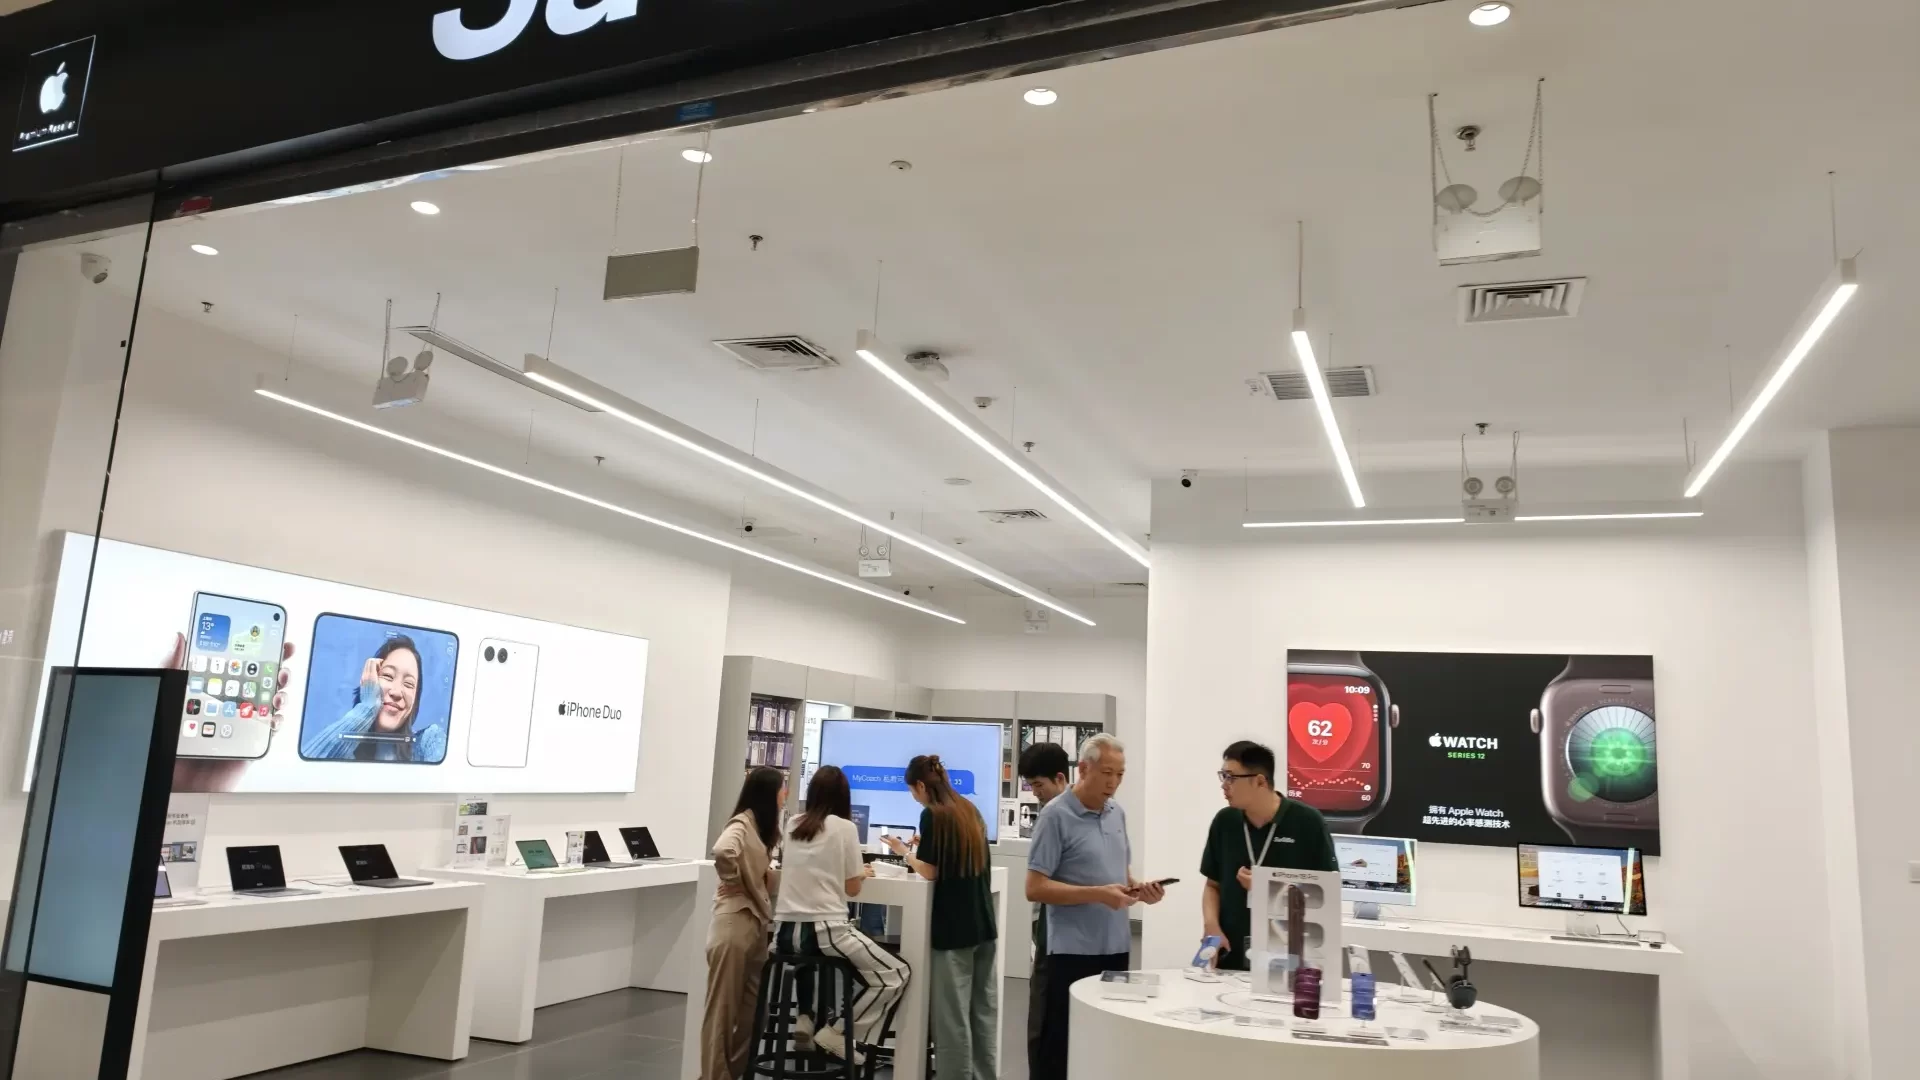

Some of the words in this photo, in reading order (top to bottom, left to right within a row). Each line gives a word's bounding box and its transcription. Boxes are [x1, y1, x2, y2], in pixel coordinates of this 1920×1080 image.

[1344, 685, 1371, 694] 10:09
[567, 701, 601, 719] iPhone
[603, 704, 622, 720] Duo
[1307, 719, 1333, 737] 62
[1442, 736, 1498, 750] WATCH
[1447, 751, 1476, 760] SERIES
[1477, 752, 1486, 760] 12
[852, 773, 882, 784] MyCoach
[1361, 794, 1371, 802] 60
[1428, 805, 1447, 815] 拥有
[1448, 806, 1474, 817] Apple
[1475, 808, 1504, 818] Watch
[1422, 815, 1511, 829] 超先进的心率感测技术
